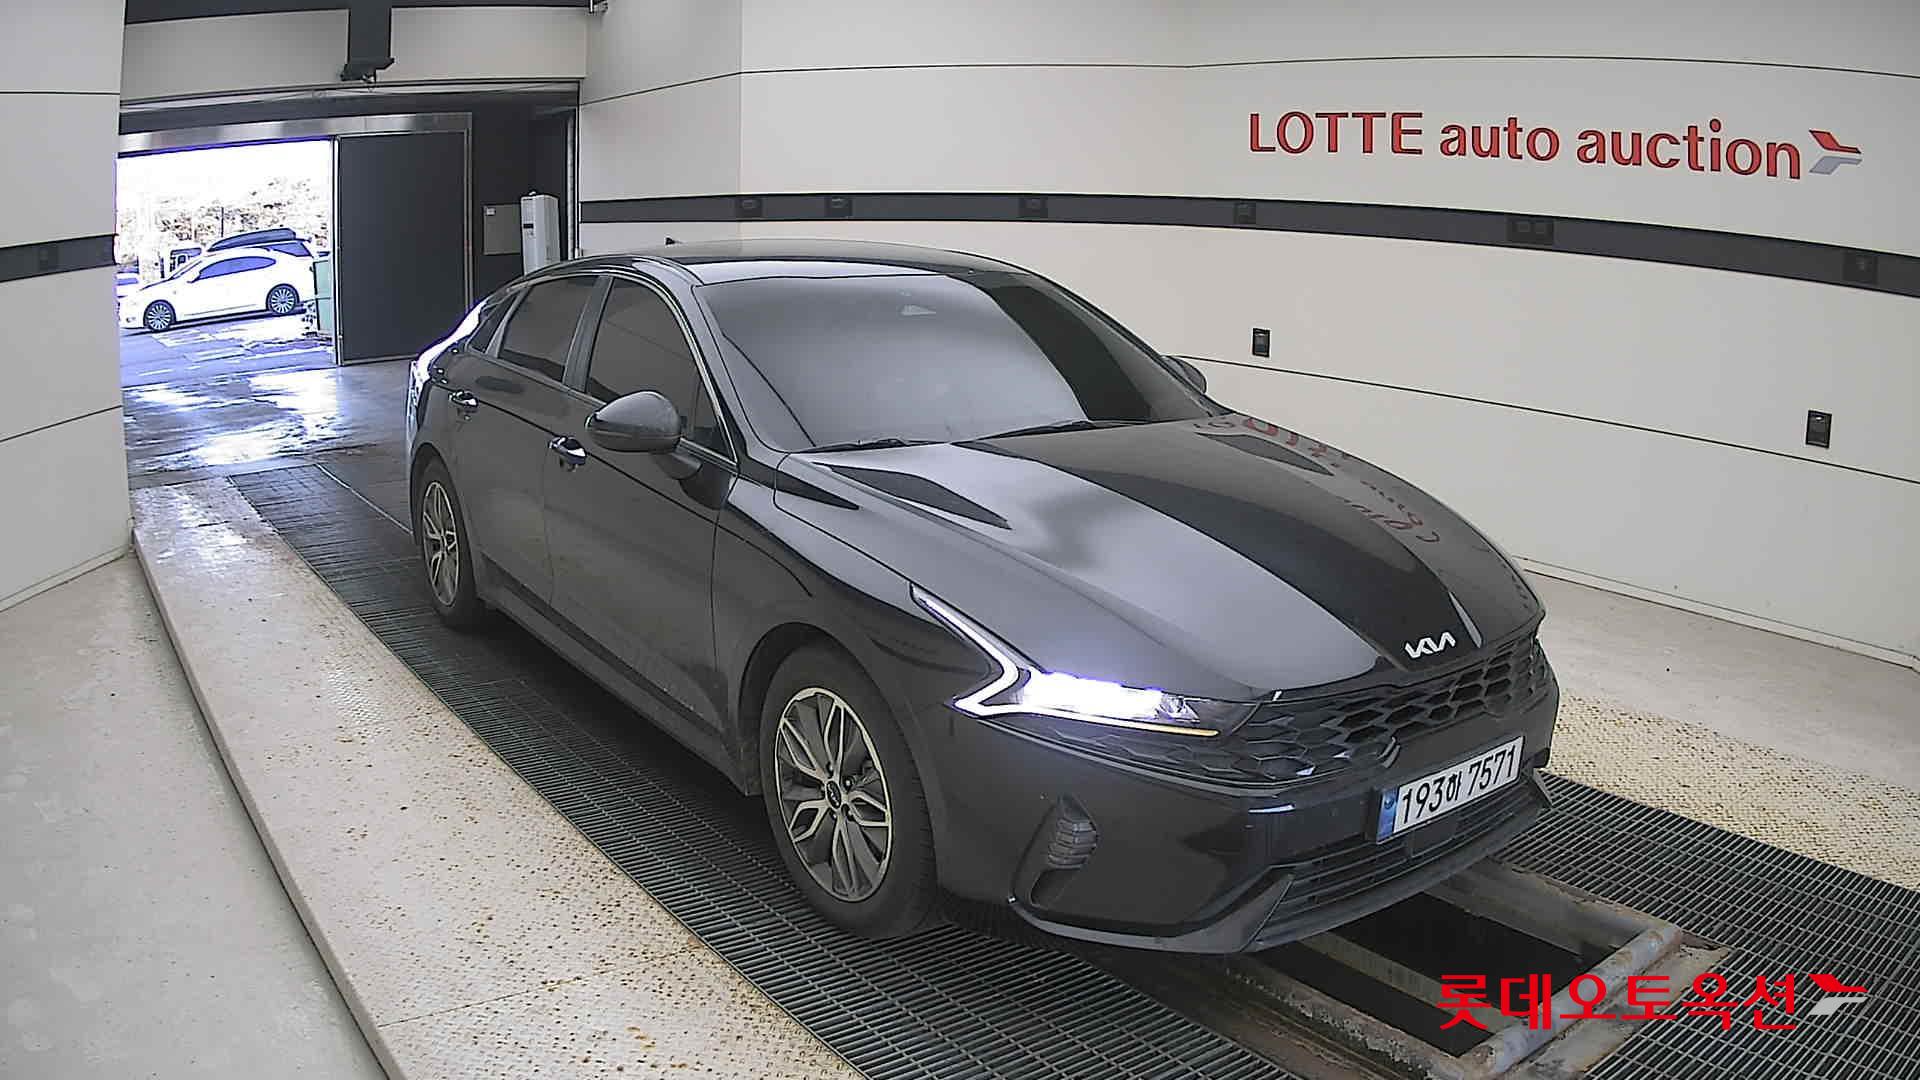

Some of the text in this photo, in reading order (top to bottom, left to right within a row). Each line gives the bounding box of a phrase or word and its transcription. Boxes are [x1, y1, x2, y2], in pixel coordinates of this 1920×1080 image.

[1248, 111, 1802, 181] LOTTE auto auction
[1467, 744, 1516, 796] 7571
